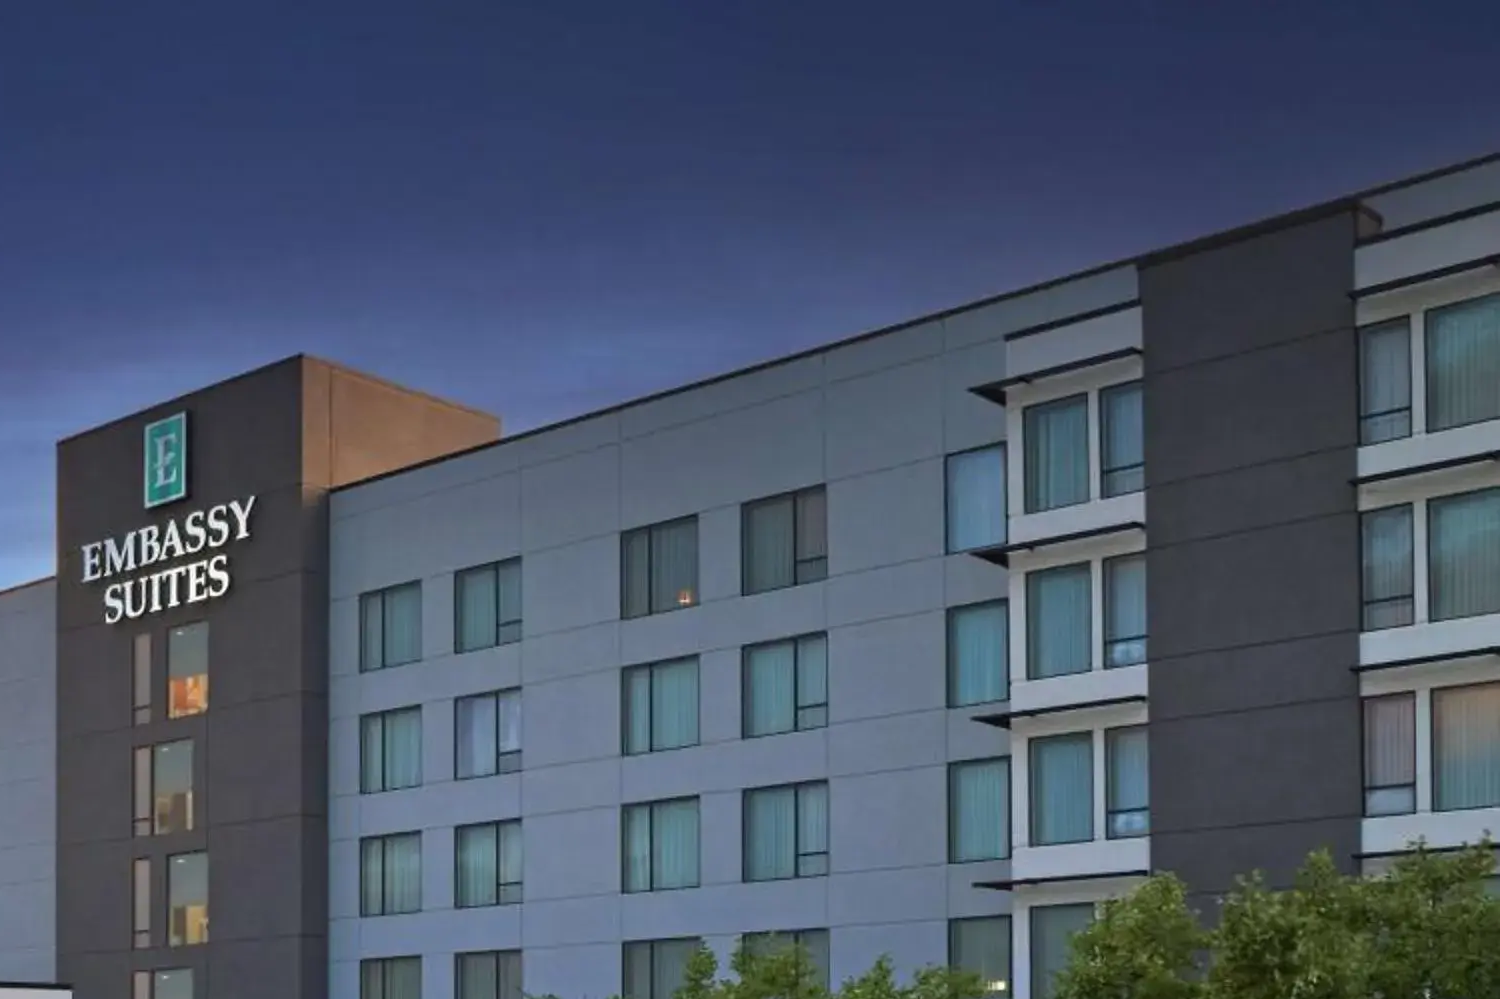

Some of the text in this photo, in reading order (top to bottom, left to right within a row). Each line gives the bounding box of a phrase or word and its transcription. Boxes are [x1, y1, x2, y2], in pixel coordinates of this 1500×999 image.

[154, 433, 177, 488] E
[81, 496, 256, 583] EMBASSY
[104, 555, 230, 624] SUITES
